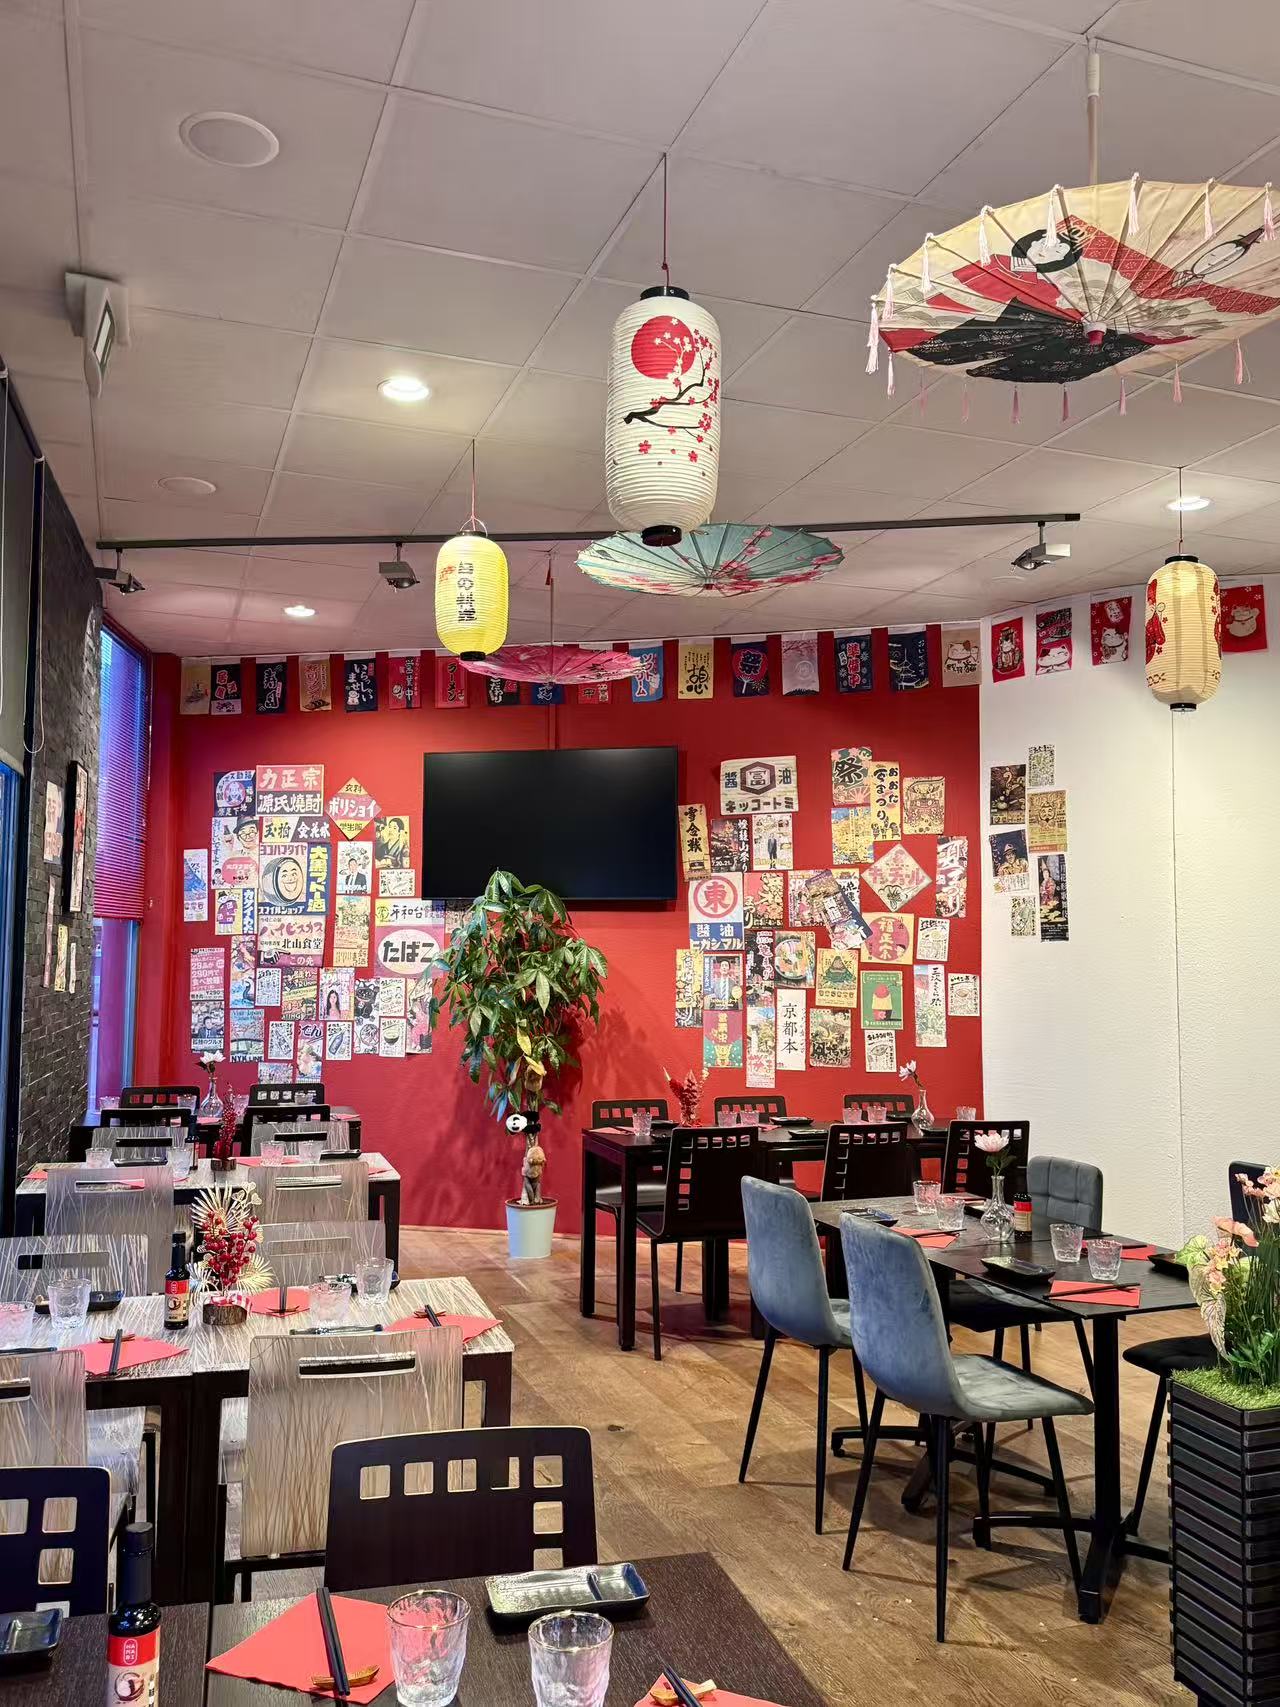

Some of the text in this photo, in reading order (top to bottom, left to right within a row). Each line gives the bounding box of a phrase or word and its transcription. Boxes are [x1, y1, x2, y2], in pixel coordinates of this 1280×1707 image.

[447, 663, 457, 702] ラーメン
[260, 767, 320, 790] 力正宗
[778, 768, 792, 784] 油
[835, 757, 863, 784] 祭
[329, 797, 376, 818] ボリショイ
[703, 881, 730, 913] 東
[260, 921, 323, 936] ハイビスカス
[281, 938, 323, 949] 北山食堂
[382, 940, 435, 962] たばこ
[290, 955, 314, 967] この先
[781, 1003, 798, 1054] 京都本
